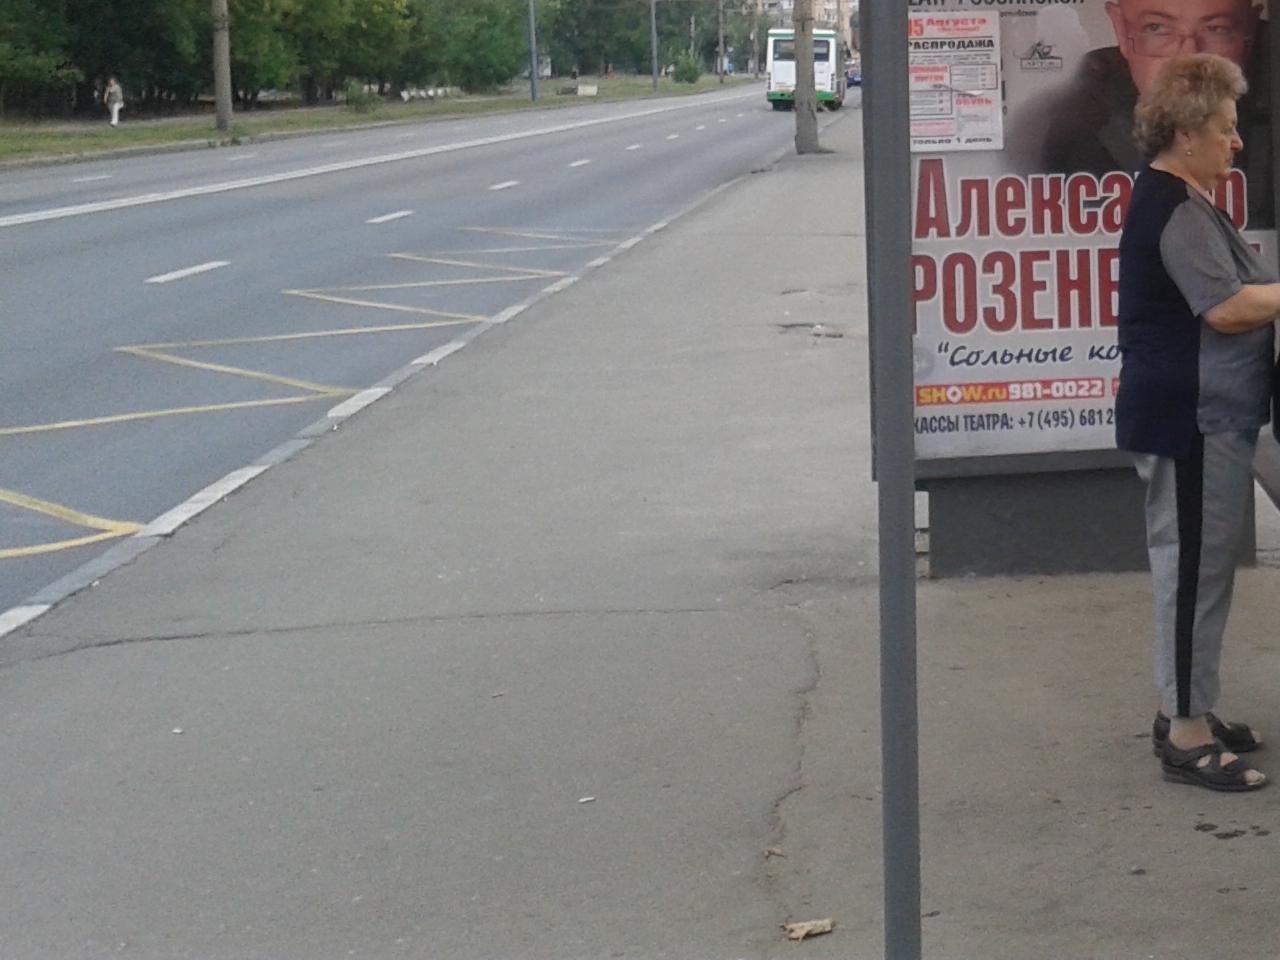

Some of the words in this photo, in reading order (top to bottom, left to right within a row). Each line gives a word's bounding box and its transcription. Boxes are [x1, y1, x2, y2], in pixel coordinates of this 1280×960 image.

[1008, 380, 1103, 400] 981-0022
[963, 412, 1014, 431] ТЕАТРА:
[1018, 412, 1034, 429] +7
[1038, 408, 1075, 430] (495)
[1080, 408, 1103, 426] 681
